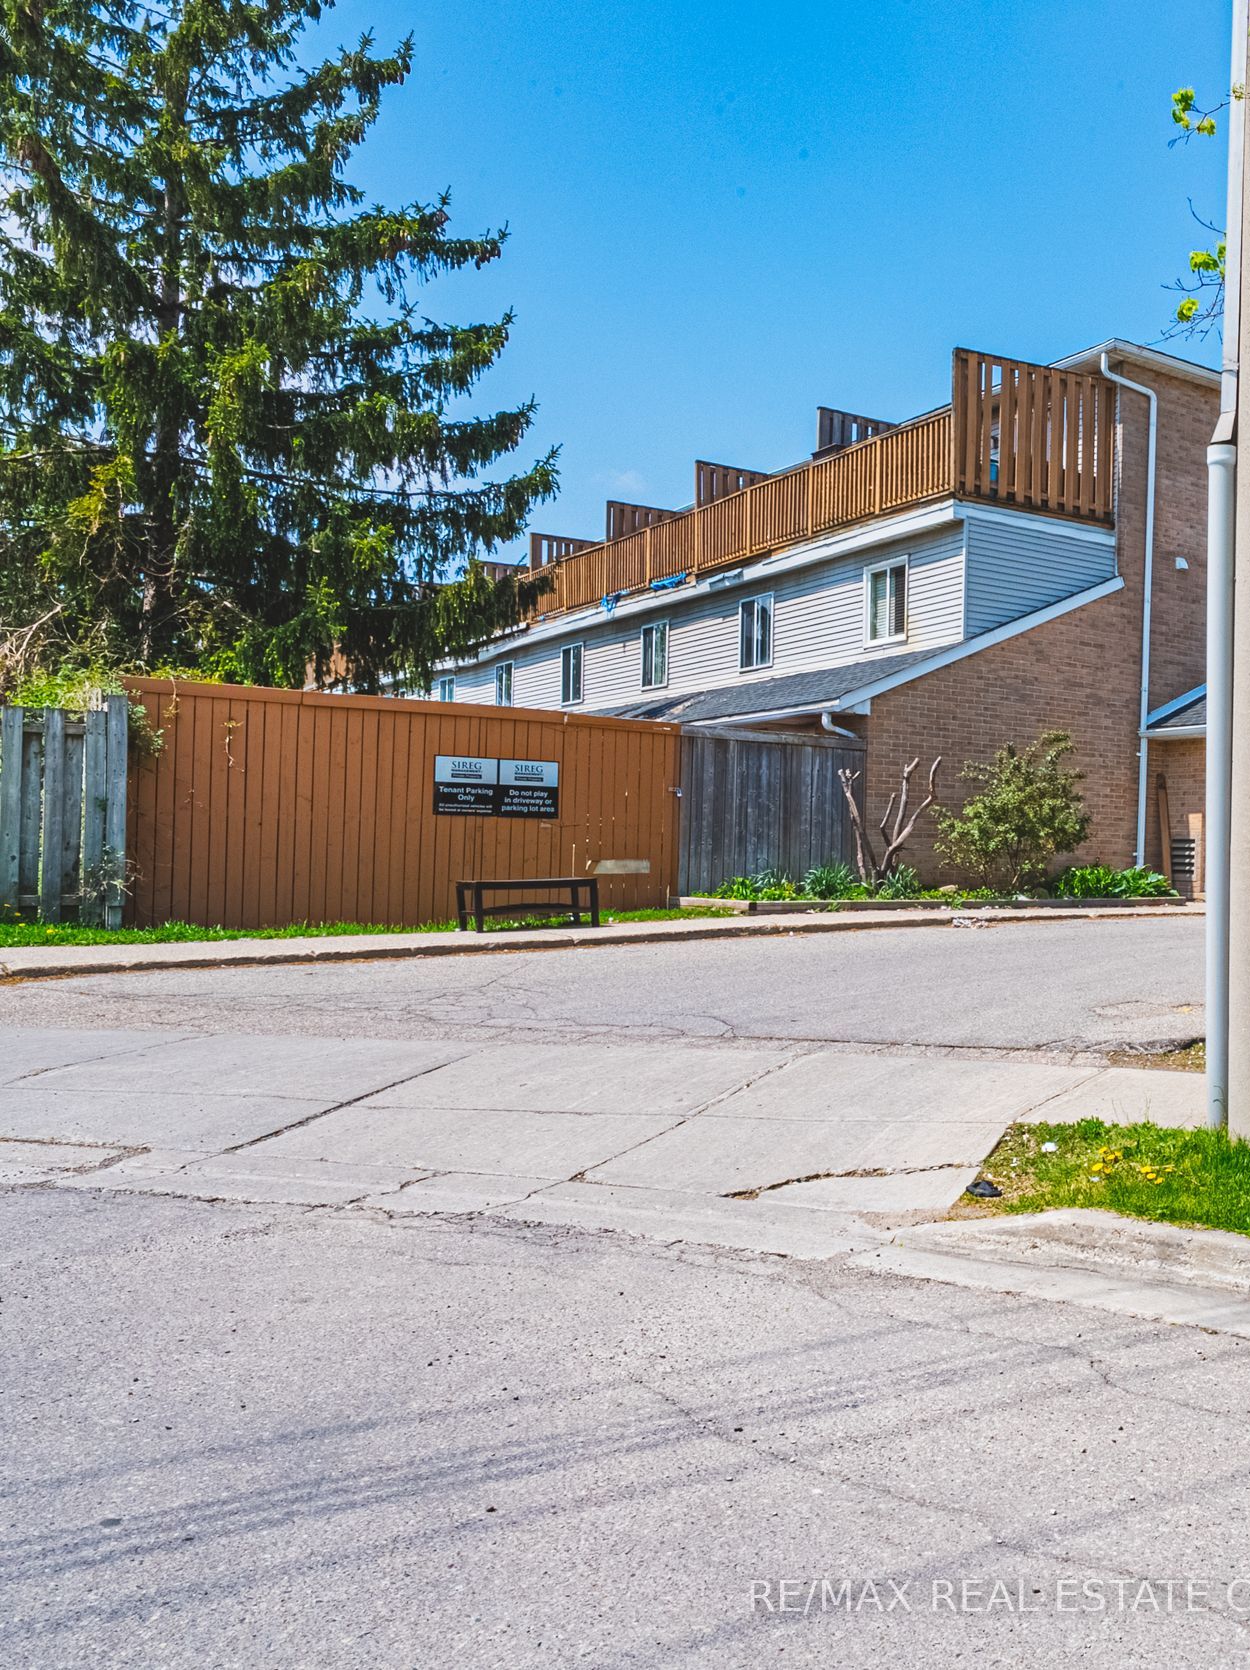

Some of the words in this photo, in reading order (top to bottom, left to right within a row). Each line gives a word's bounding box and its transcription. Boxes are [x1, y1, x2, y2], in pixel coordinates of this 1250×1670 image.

[451, 760, 482, 770] SIREG
[514, 764, 544, 773] SIREG
[466, 787, 493, 795] Parking
[457, 794, 475, 802] Only
[501, 805, 528, 813] parking
